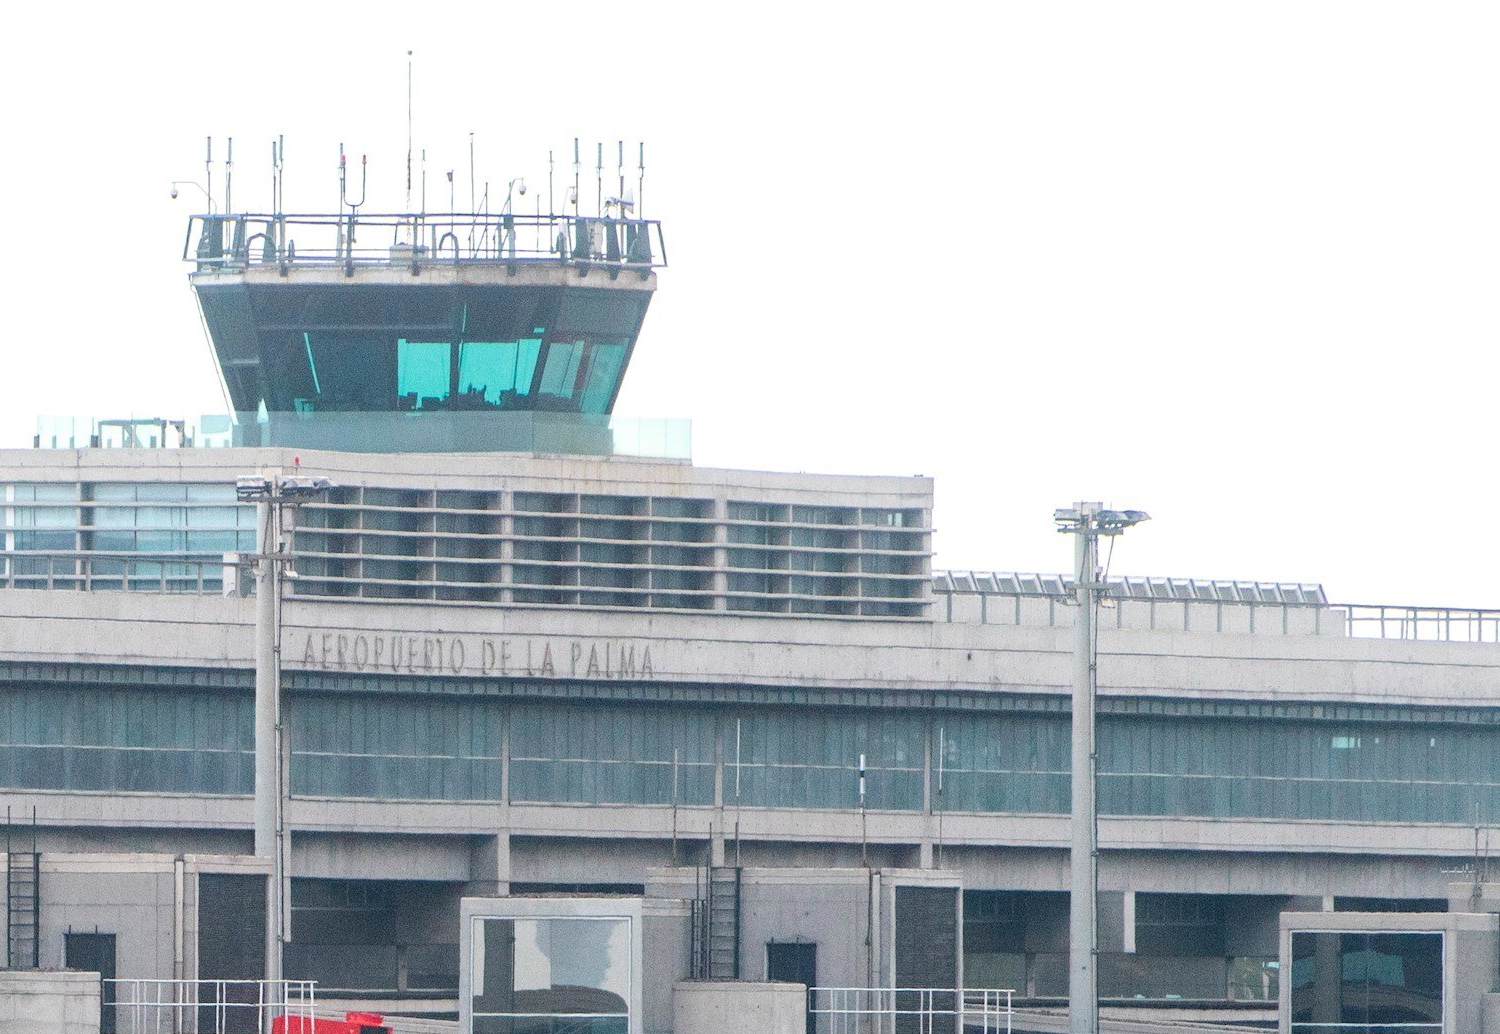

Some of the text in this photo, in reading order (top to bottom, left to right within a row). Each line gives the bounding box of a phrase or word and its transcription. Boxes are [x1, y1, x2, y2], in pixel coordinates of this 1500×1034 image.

[302, 633, 654, 679] AEROPUERTO DE LA PALMA
